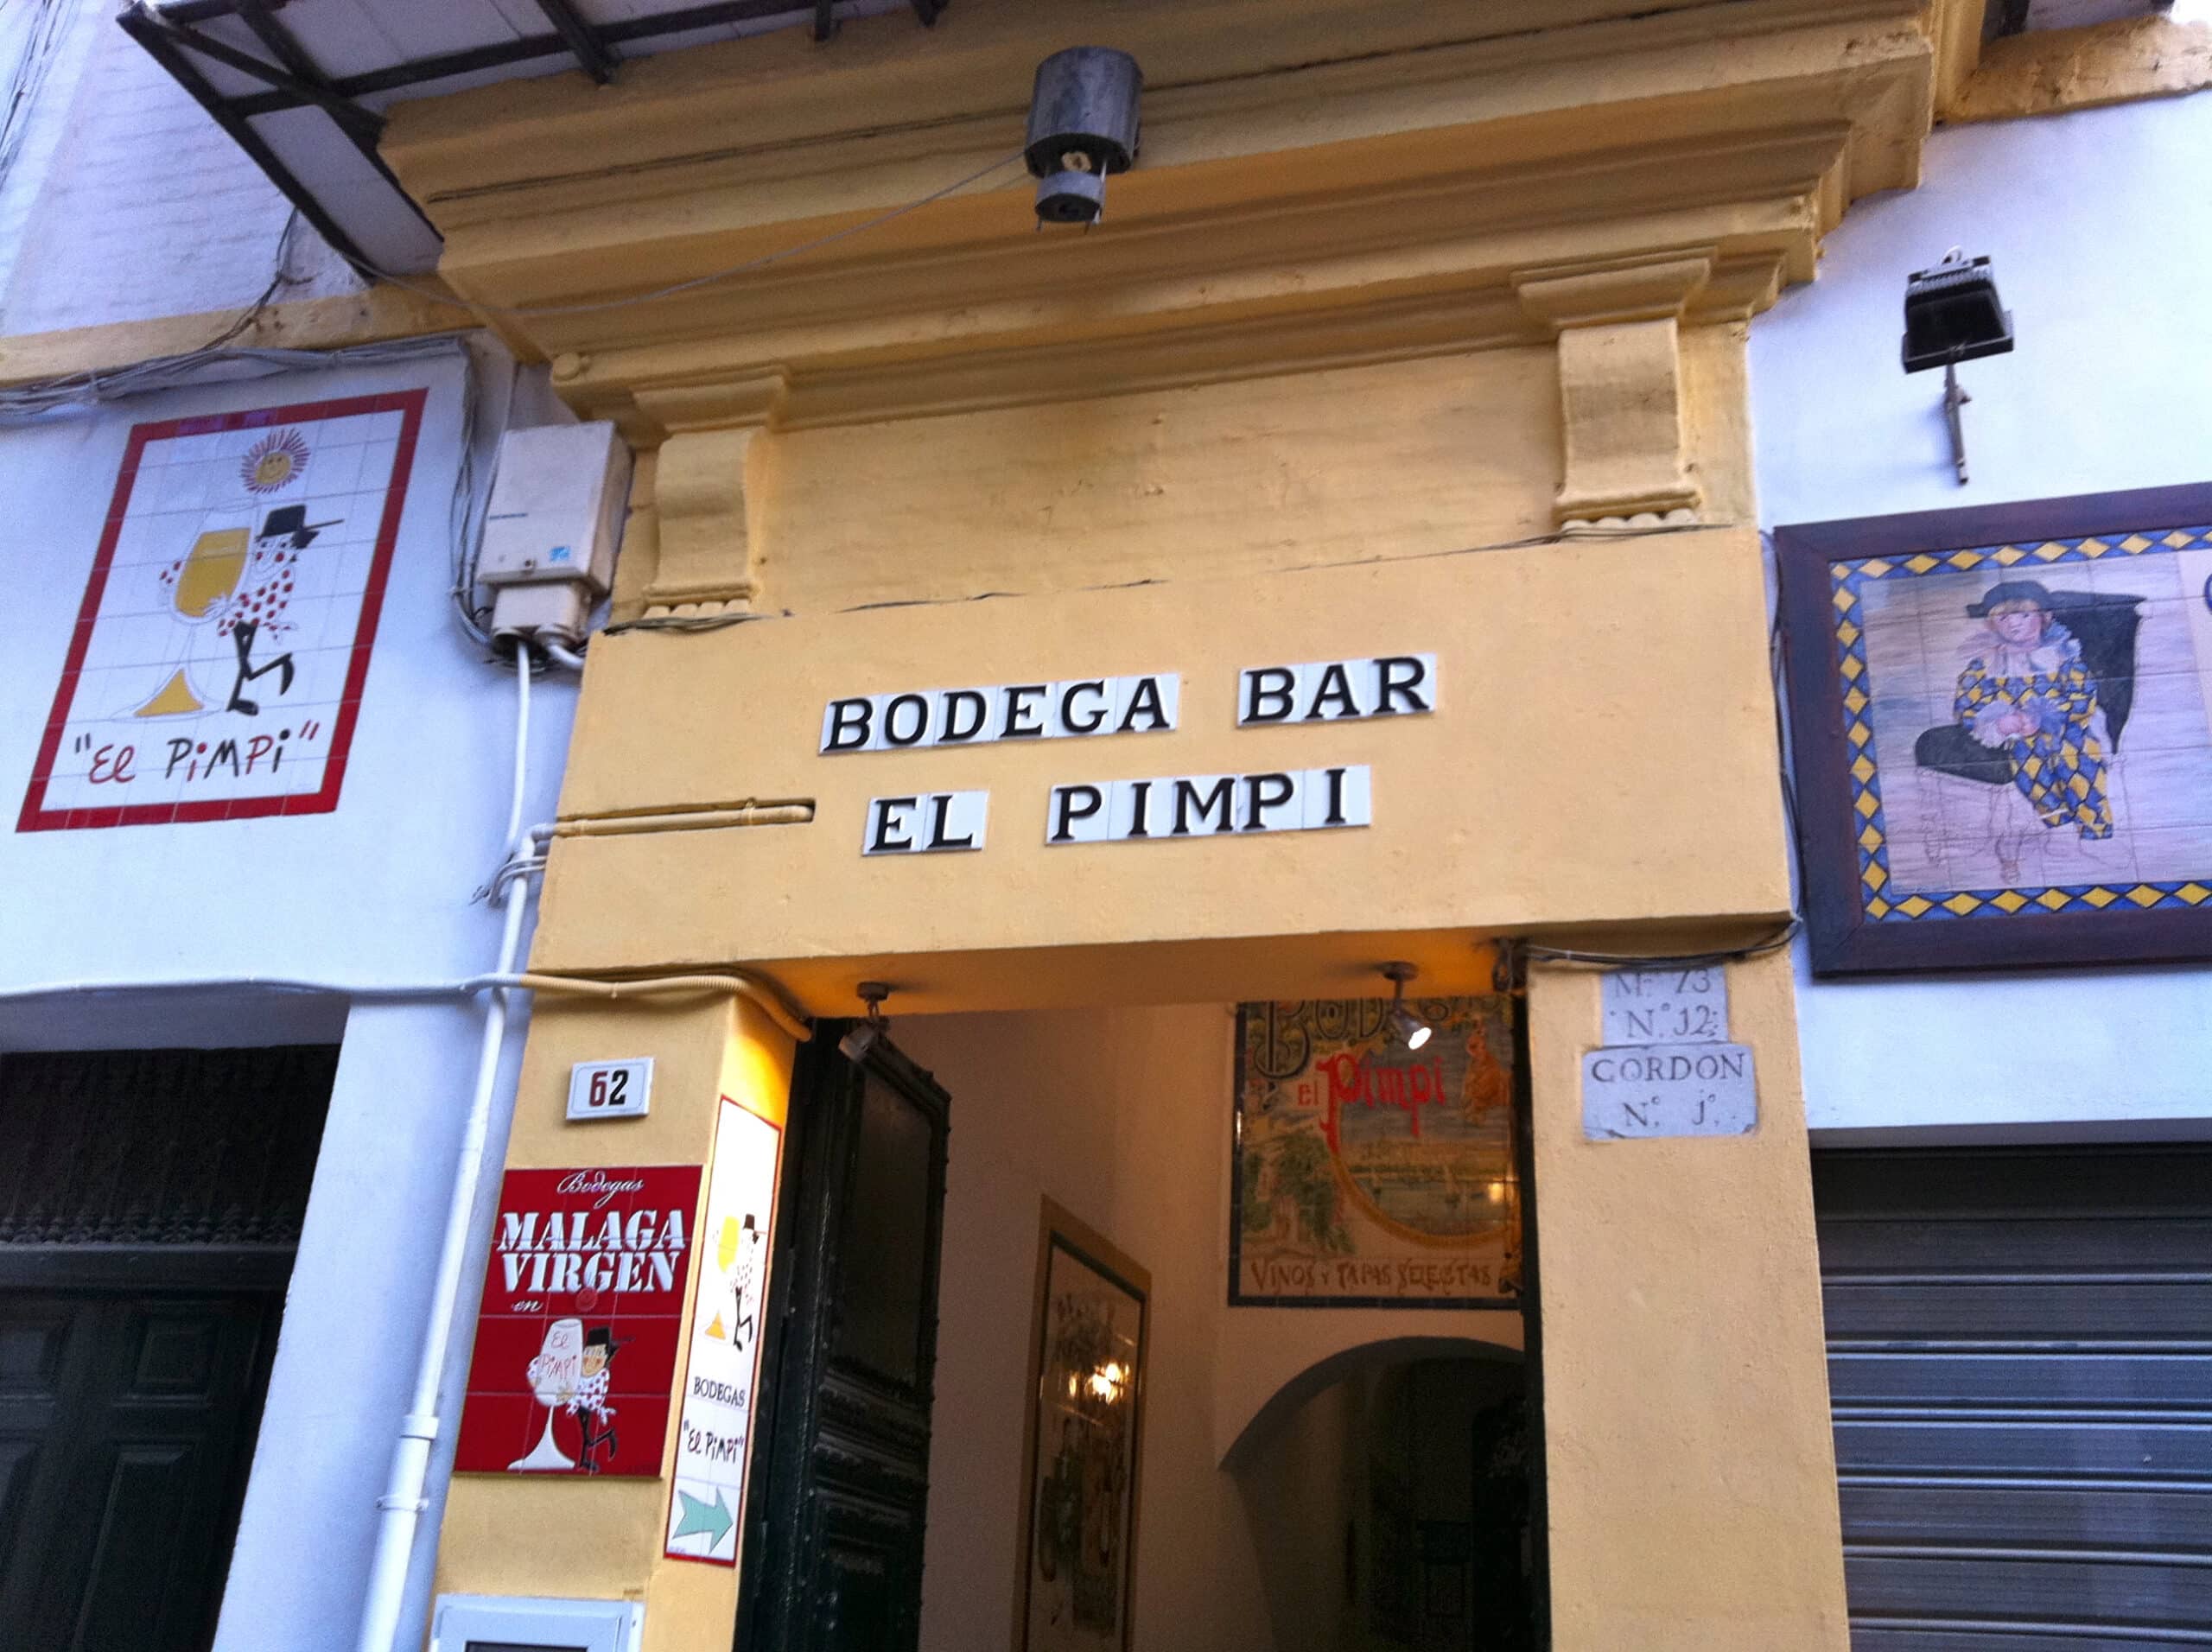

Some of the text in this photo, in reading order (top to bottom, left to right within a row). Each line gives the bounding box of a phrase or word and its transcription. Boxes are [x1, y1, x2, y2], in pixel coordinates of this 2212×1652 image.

[823, 657, 1431, 752] BODEGA BAR
[868, 768, 1347, 851] EL PIMPI
[1591, 1052, 1745, 1083] CORDON
[588, 1069, 630, 1108] 62
[556, 1169, 645, 1210] Bodegas
[496, 1210, 686, 1252] MALAGA
[501, 1250, 681, 1294] VIRGEN
[512, 1299, 543, 1312] en
[693, 1376, 746, 1407] BODEGAS
